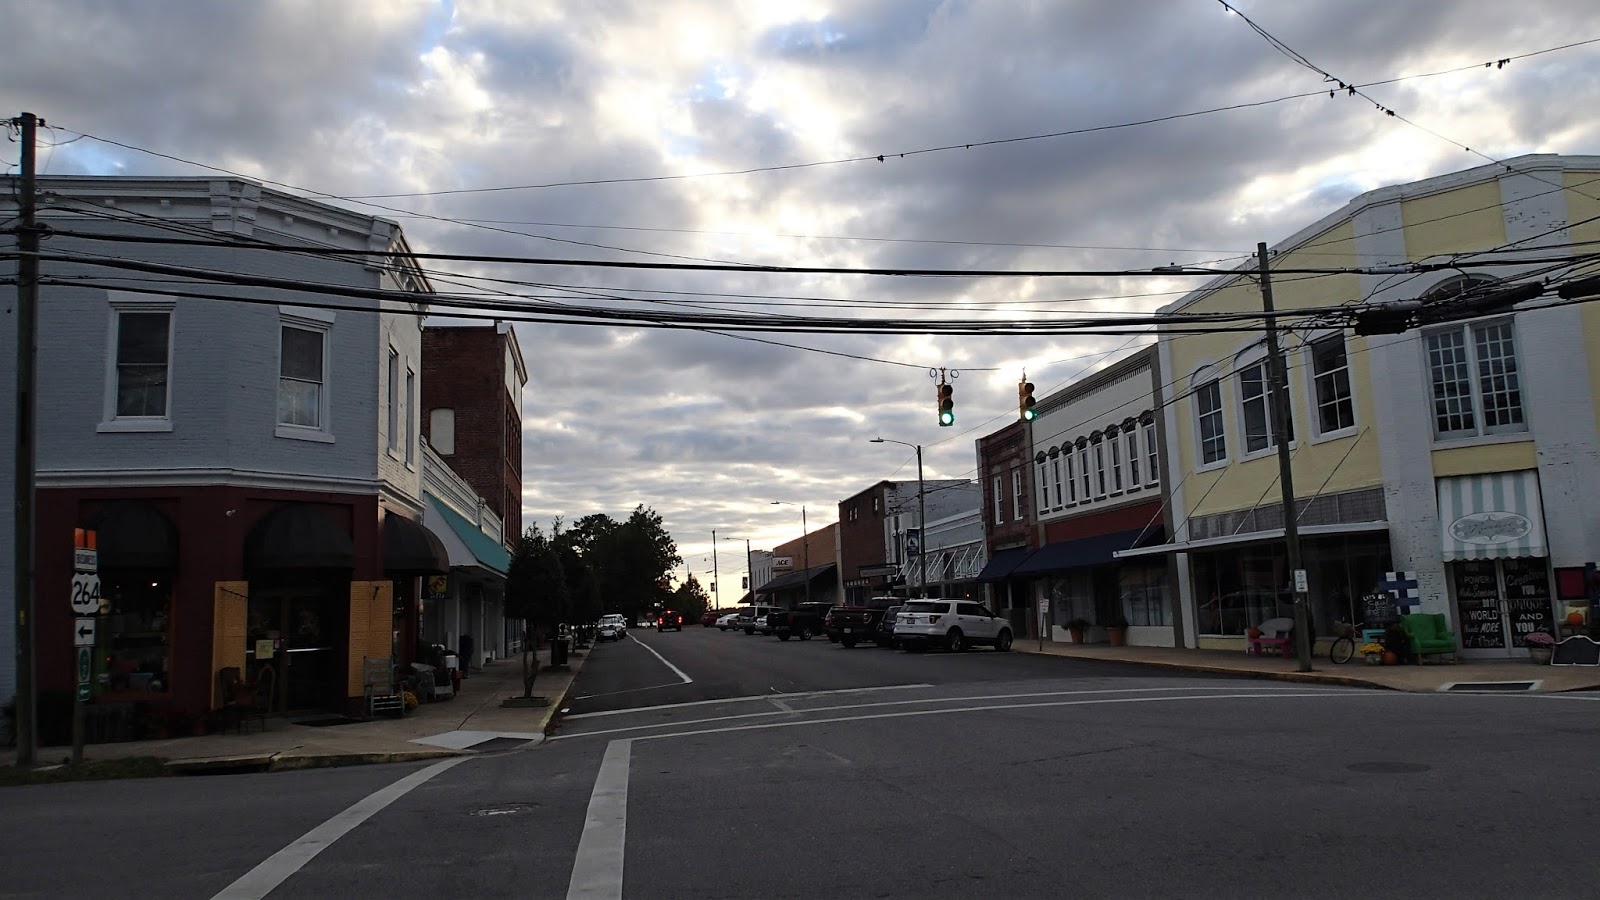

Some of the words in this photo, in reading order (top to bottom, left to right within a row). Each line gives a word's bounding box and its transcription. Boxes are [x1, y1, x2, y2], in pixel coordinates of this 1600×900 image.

[1463, 575, 1489, 584] POWER
[73, 581, 99, 605] 264
[1521, 585, 1536, 595] YOU
[1469, 610, 1499, 620] WORLD
[1519, 612, 1544, 620] AND
[1480, 622, 1501, 633] MORE
[1515, 622, 1535, 633] YOU
